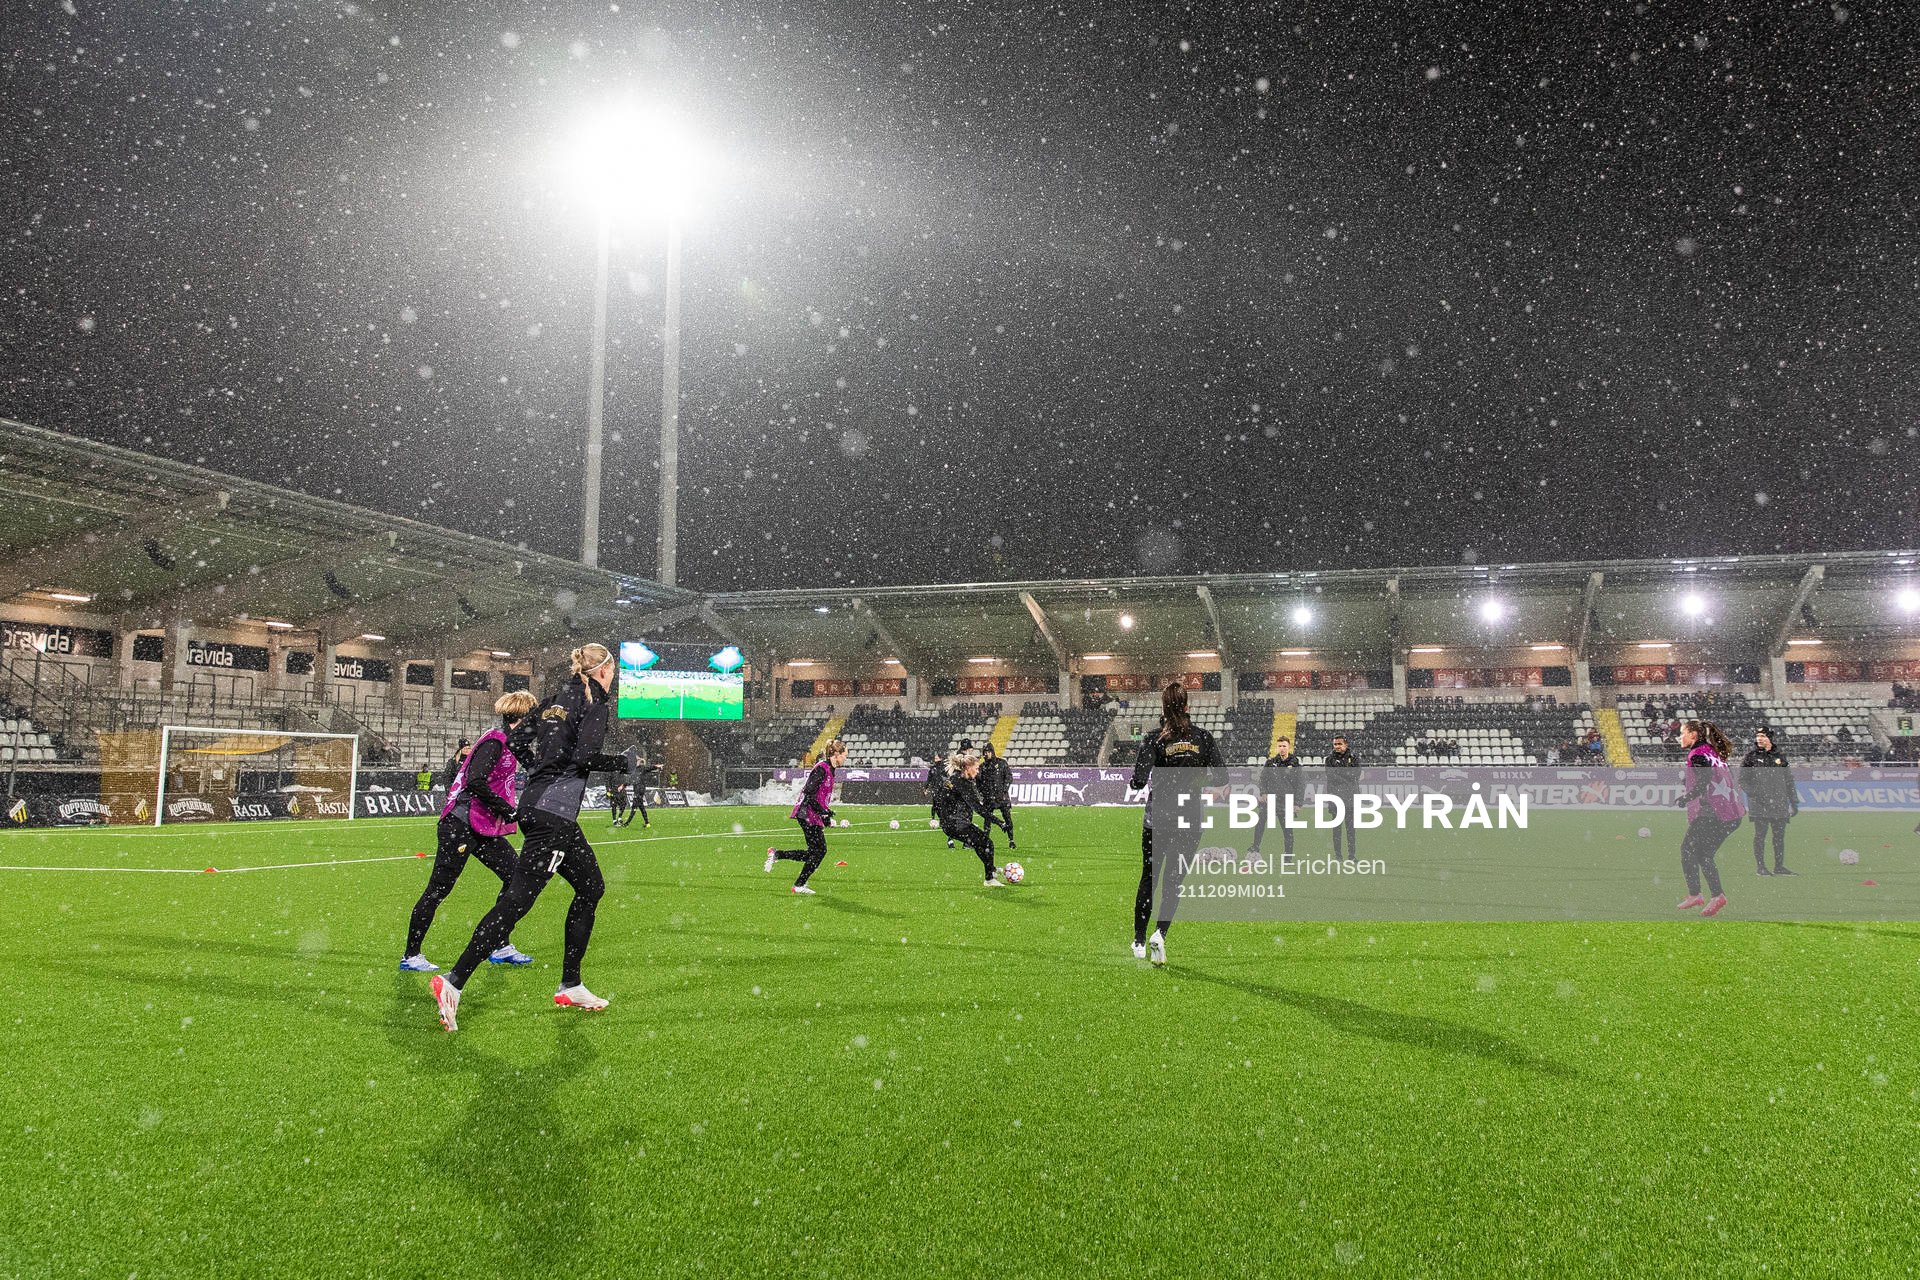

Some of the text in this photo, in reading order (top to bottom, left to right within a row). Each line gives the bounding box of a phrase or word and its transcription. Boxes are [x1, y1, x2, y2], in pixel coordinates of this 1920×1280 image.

[187, 646, 232, 667] ravida
[818, 684, 851, 692] BRA
[1101, 773, 1124, 781] RASTA
[1493, 771, 1533, 779] BRIXLY
[1813, 771, 1852, 780] SKF
[1008, 784, 1064, 802] PUMA
[1359, 784, 1419, 804] UMA
[1490, 784, 1580, 804] FASTER
[1809, 788, 1920, 803] WOMEN'S
[233, 804, 272, 817] RASTA
[317, 803, 350, 814] RASTA
[365, 795, 435, 814] BRIXLY
[548, 850, 565, 873] 12
